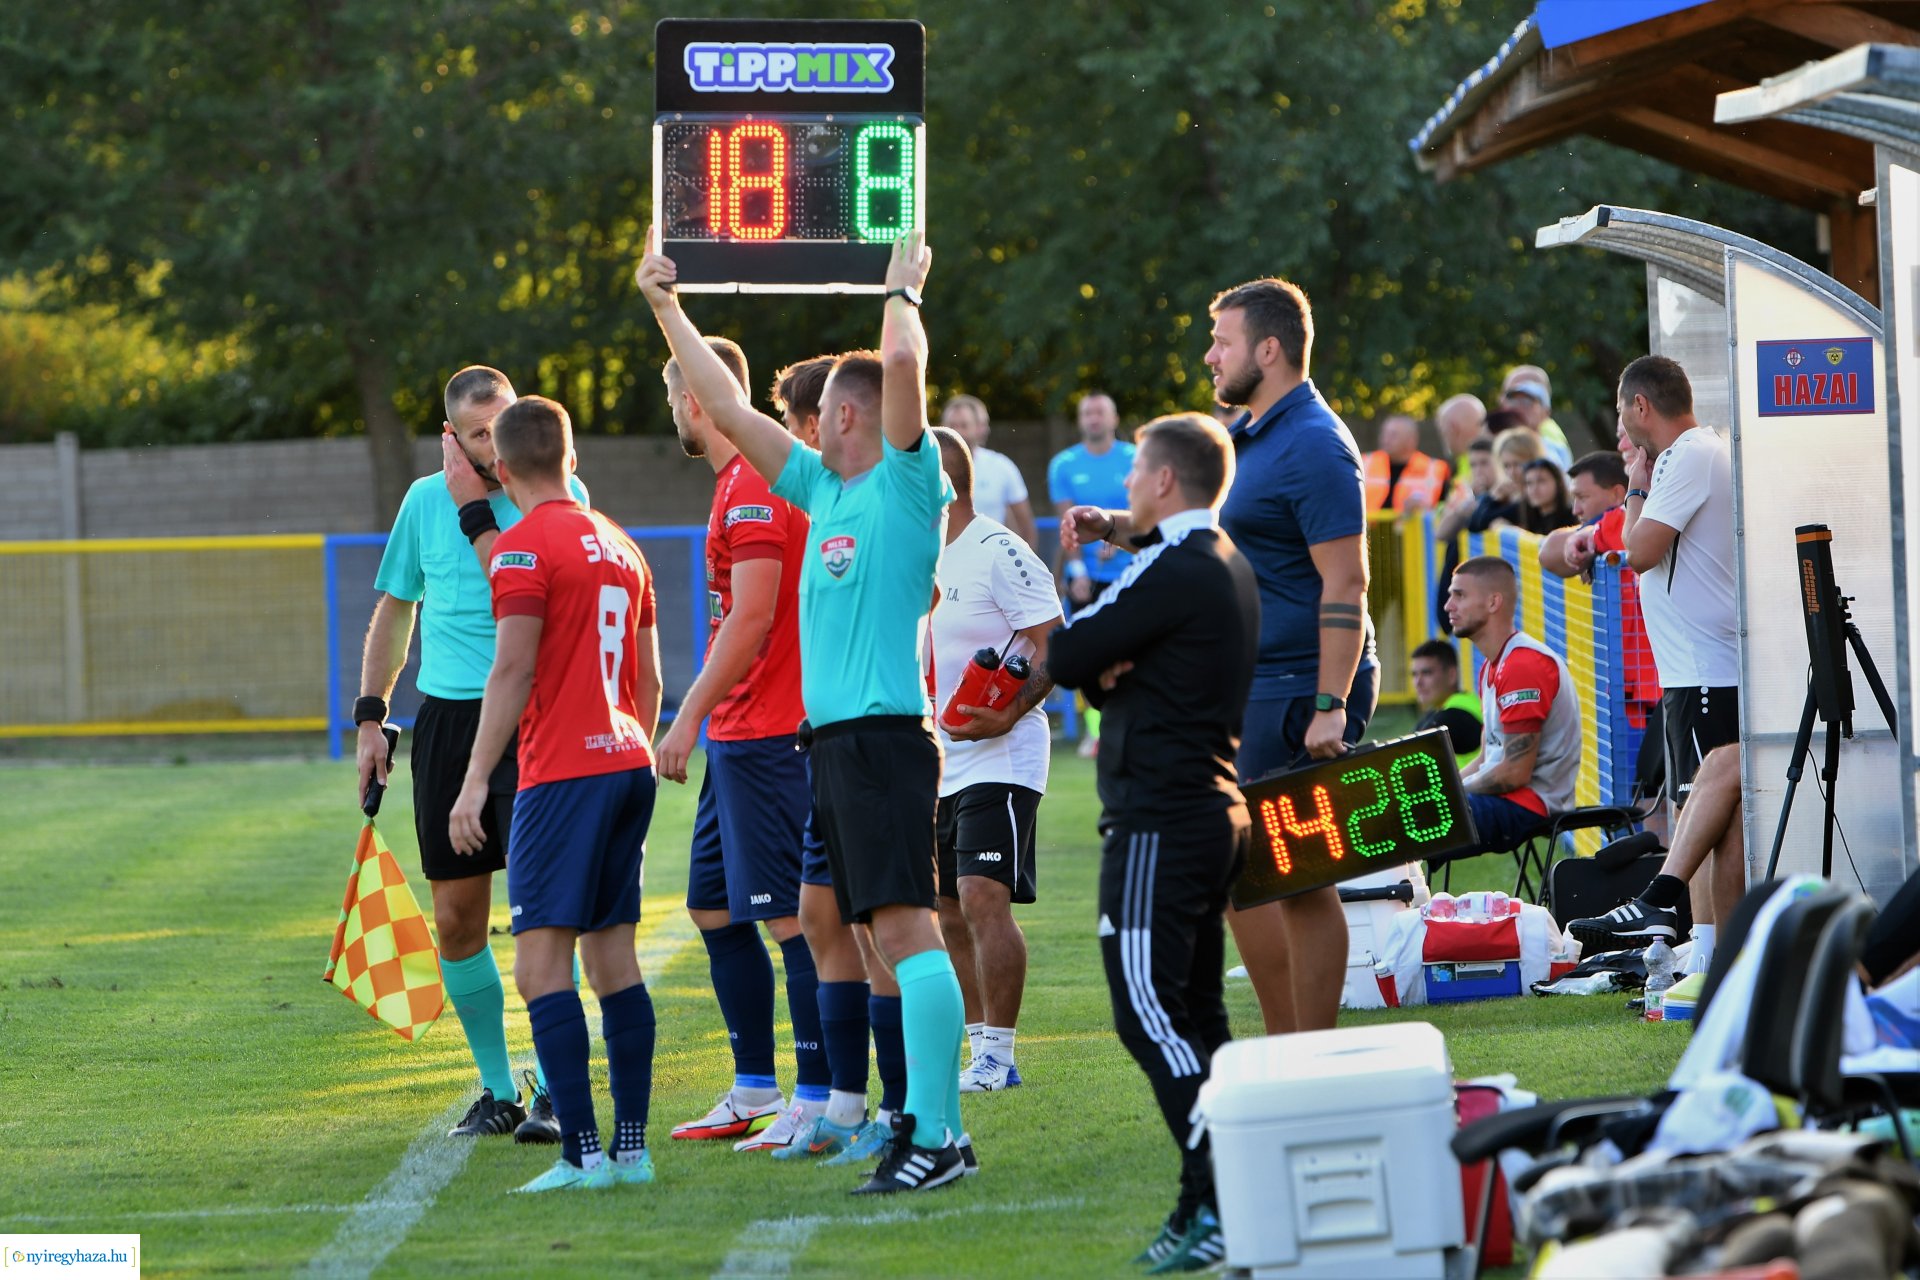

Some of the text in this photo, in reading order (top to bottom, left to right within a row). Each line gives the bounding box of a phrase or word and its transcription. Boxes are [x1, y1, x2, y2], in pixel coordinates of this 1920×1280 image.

[708, 124, 914, 240] 18 8
[1773, 372, 1858, 407] HAZAI
[597, 584, 631, 706] 8
[1259, 751, 1454, 875] 14 28
[750, 893, 772, 905] JAKO
